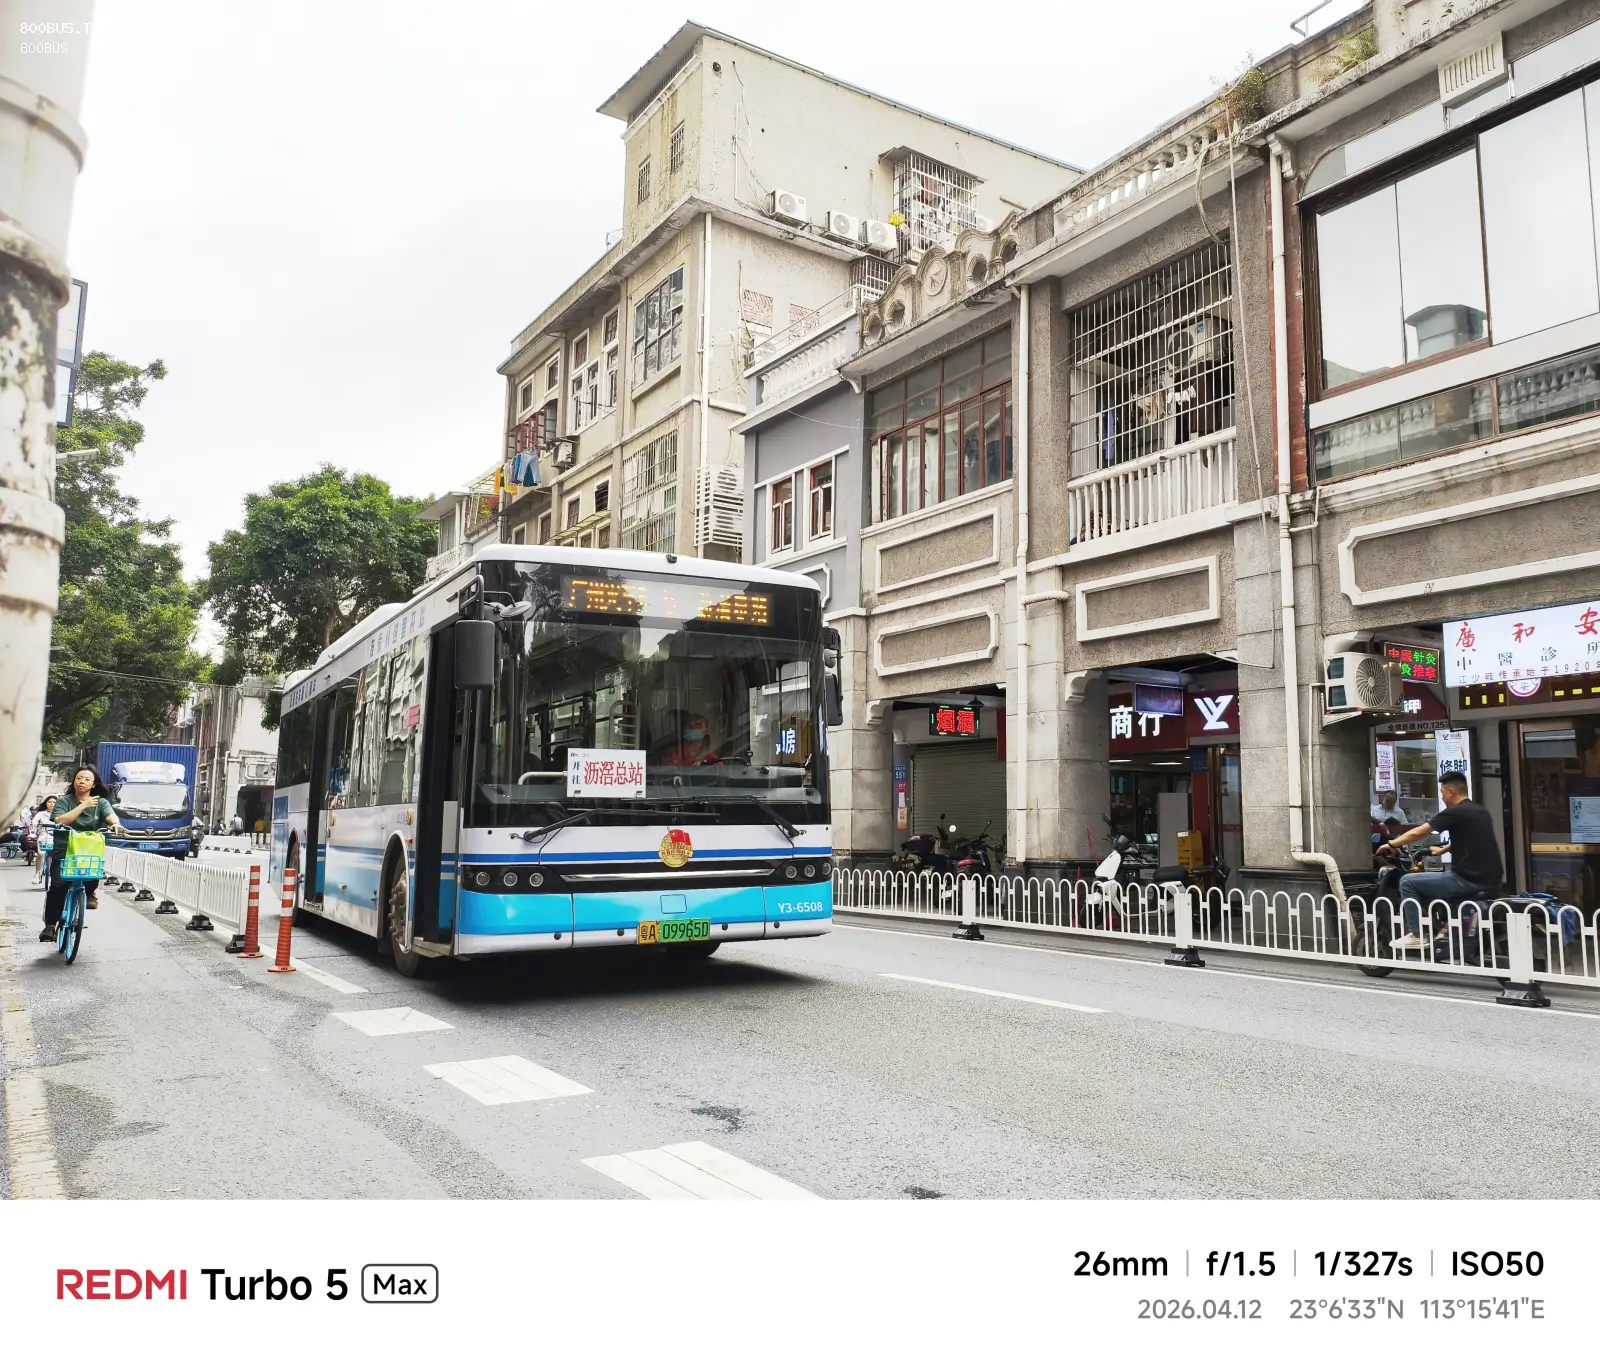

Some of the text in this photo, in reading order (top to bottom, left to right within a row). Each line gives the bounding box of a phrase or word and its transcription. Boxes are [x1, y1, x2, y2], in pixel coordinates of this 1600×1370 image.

[1388, 647, 1436, 666] 中医针灸
[1401, 663, 1437, 679] 灸推拿
[572, 760, 581, 785] 开往
[584, 760, 643, 786] 沥滘总站
[778, 901, 823, 914] Y3-6508
